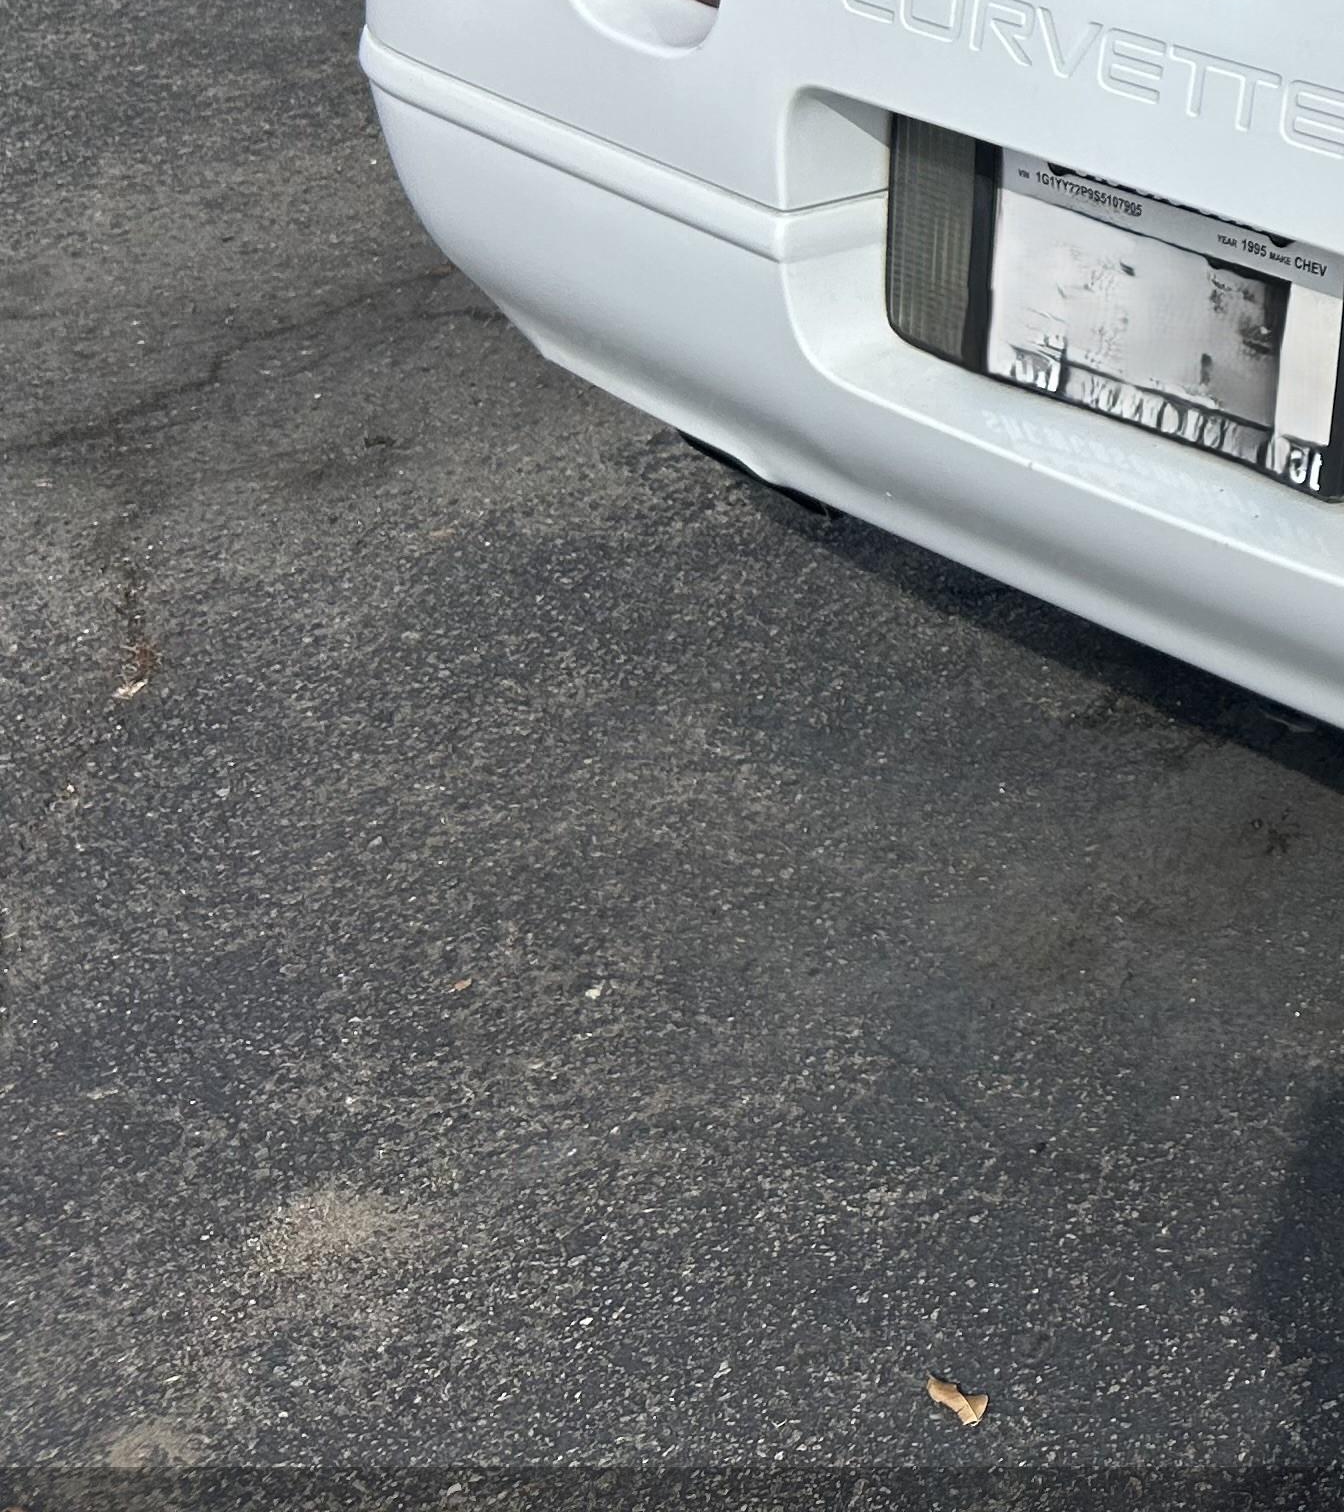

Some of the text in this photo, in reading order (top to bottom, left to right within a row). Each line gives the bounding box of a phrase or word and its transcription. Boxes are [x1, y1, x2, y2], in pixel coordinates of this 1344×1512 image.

[1217, 234, 1238, 248] YEAR
[1241, 239, 1267, 257] 1995
[1269, 251, 1292, 266] MAKE
[1294, 256, 1328, 277] CHEV
